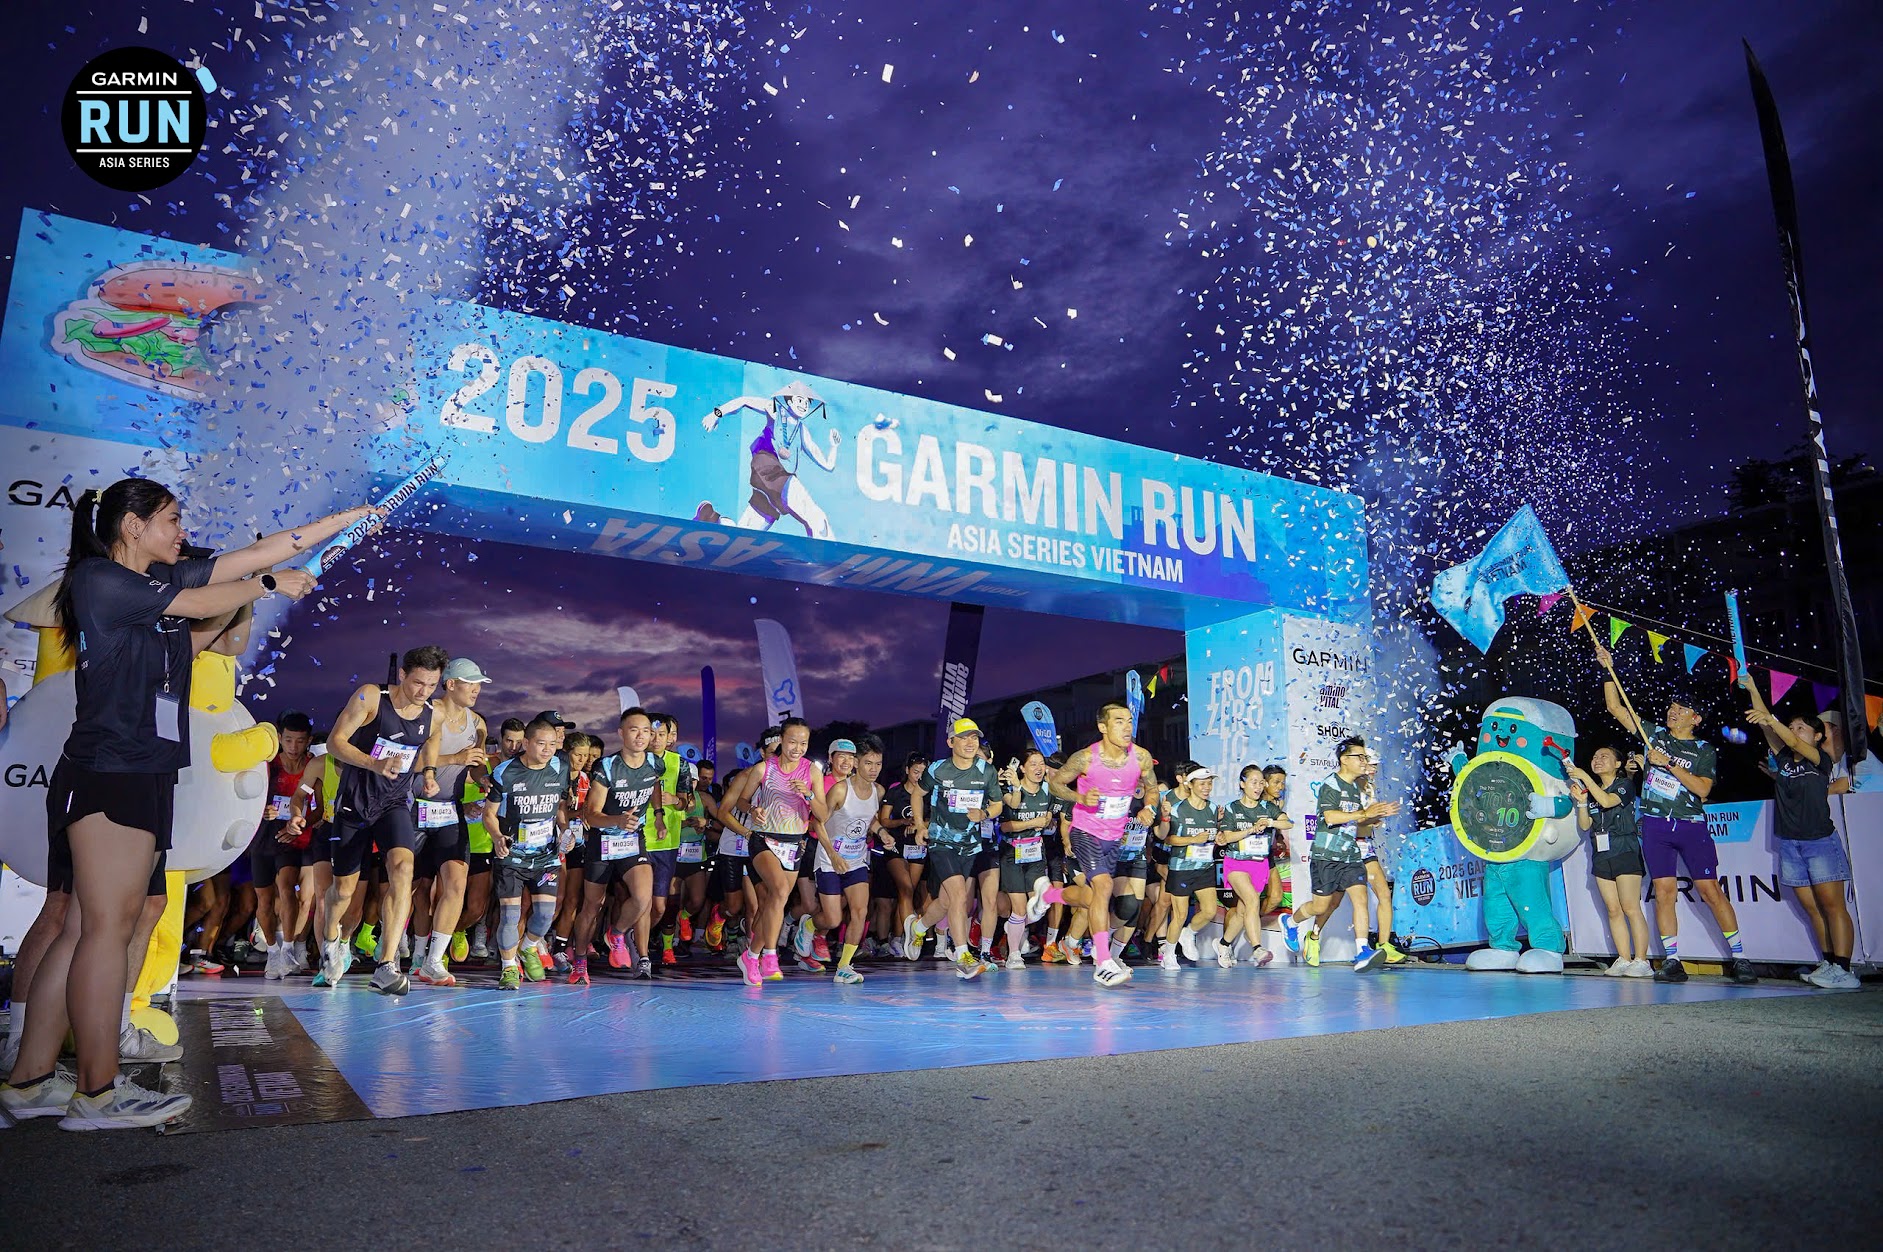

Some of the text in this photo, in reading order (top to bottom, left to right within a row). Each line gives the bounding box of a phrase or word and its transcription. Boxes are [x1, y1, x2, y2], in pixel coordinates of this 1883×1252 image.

[440, 343, 678, 463] 2025
[856, 422, 1256, 563] GARMIN RUN
[347, 516, 378, 544] 2025
[591, 517, 784, 568] ASIA
[947, 523, 1184, 584] ASIA SERIES VIETNAM
[1293, 647, 1368, 673] GARMIN
[940, 662, 958, 710] VITAL
[1209, 660, 1275, 705] FROM
[1320, 695, 1340, 709] VITAL
[1206, 697, 1264, 736] ZERO
[1672, 756, 1692, 769] ZERO
[513, 793, 560, 806] FROM ZERO
[614, 790, 638, 801] FROM
[619, 799, 630, 808] TO
[519, 803, 554, 815] TO HERO
[1018, 812, 1036, 820] FROM
[1720, 811, 1739, 822] RUN
[1496, 807, 1520, 828] 10
[1236, 822, 1252, 830] FROM
[1438, 864, 1465, 880] 2025
[1413, 880, 1434, 896] RUN
